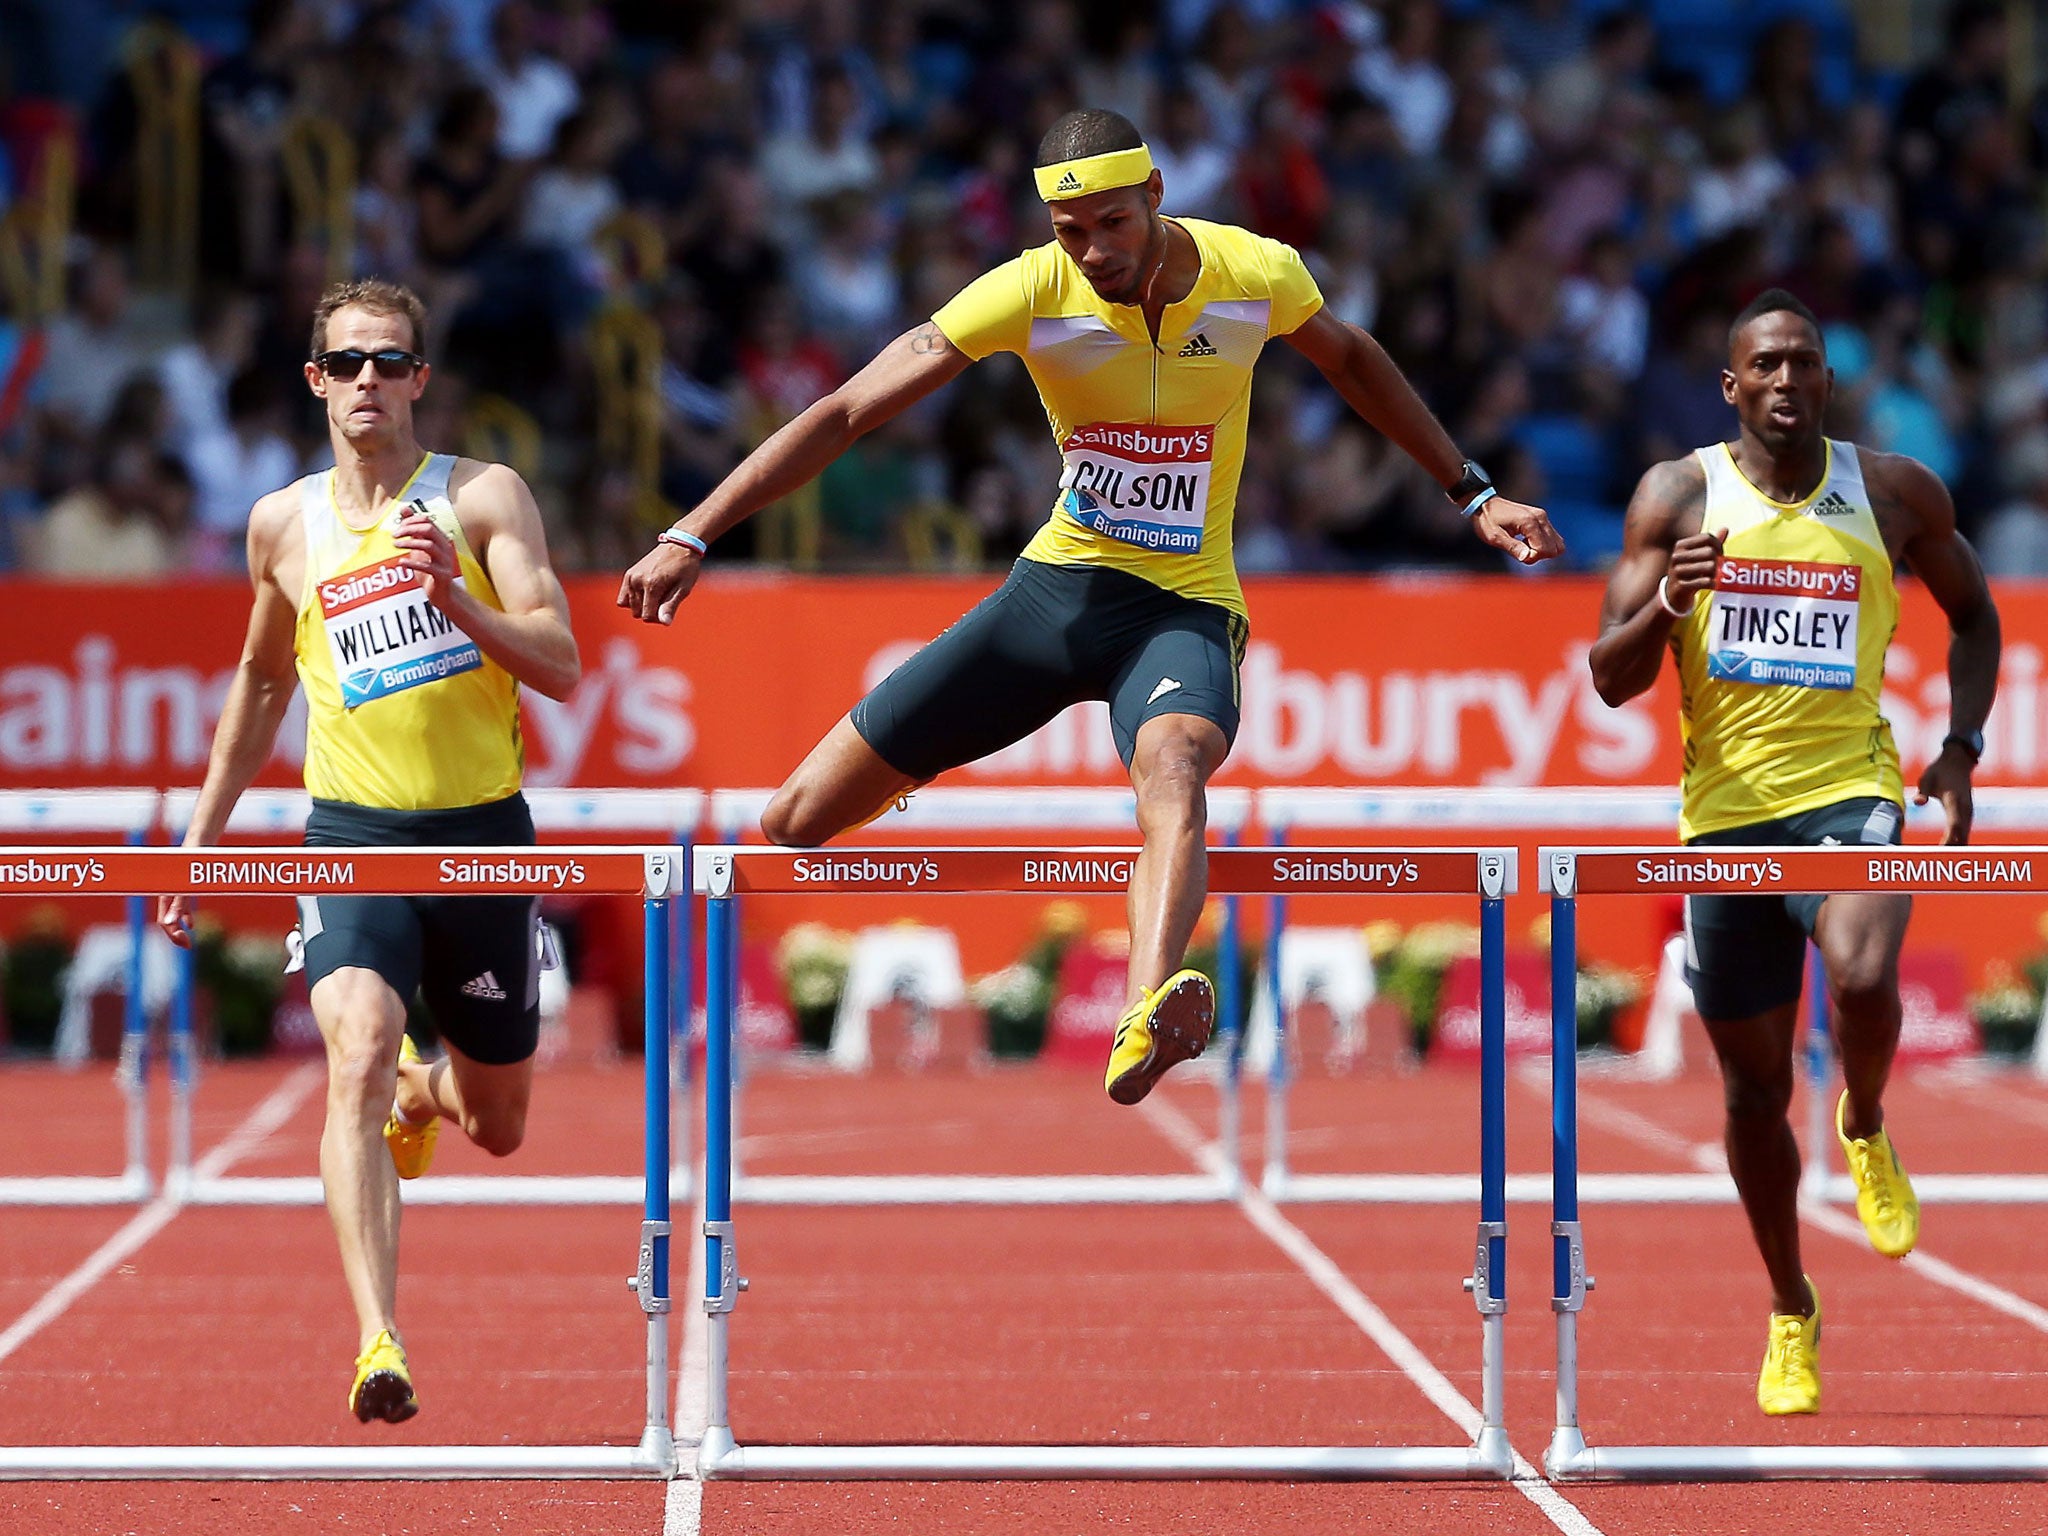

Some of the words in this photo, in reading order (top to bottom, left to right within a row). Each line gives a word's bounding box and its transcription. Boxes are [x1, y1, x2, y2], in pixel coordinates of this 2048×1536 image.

[1178, 347, 1218, 358] adidas
[1069, 428, 1208, 459] Sainsbury's
[1814, 503, 1856, 516] adidas
[1093, 513, 1198, 549] Birmingham
[321, 562, 416, 610] Sainsbu
[1720, 561, 1856, 596] Sainsbury's
[1720, 605, 1850, 650] TINSLEY
[382, 648, 479, 690] Birmingham
[1750, 660, 1851, 687] Birmingham
[189, 861, 355, 885] BIRMINGHAM
[438, 858, 586, 889] Sainsbury's
[792, 857, 939, 887] Sainsbury's
[1023, 860, 1134, 883] BIRMING
[1272, 857, 1419, 888] Sainsbury's
[1636, 857, 1783, 887] Sainsbury's
[1867, 860, 2033, 883] BIRMINGHAM
[462, 985, 507, 1000] adidas
